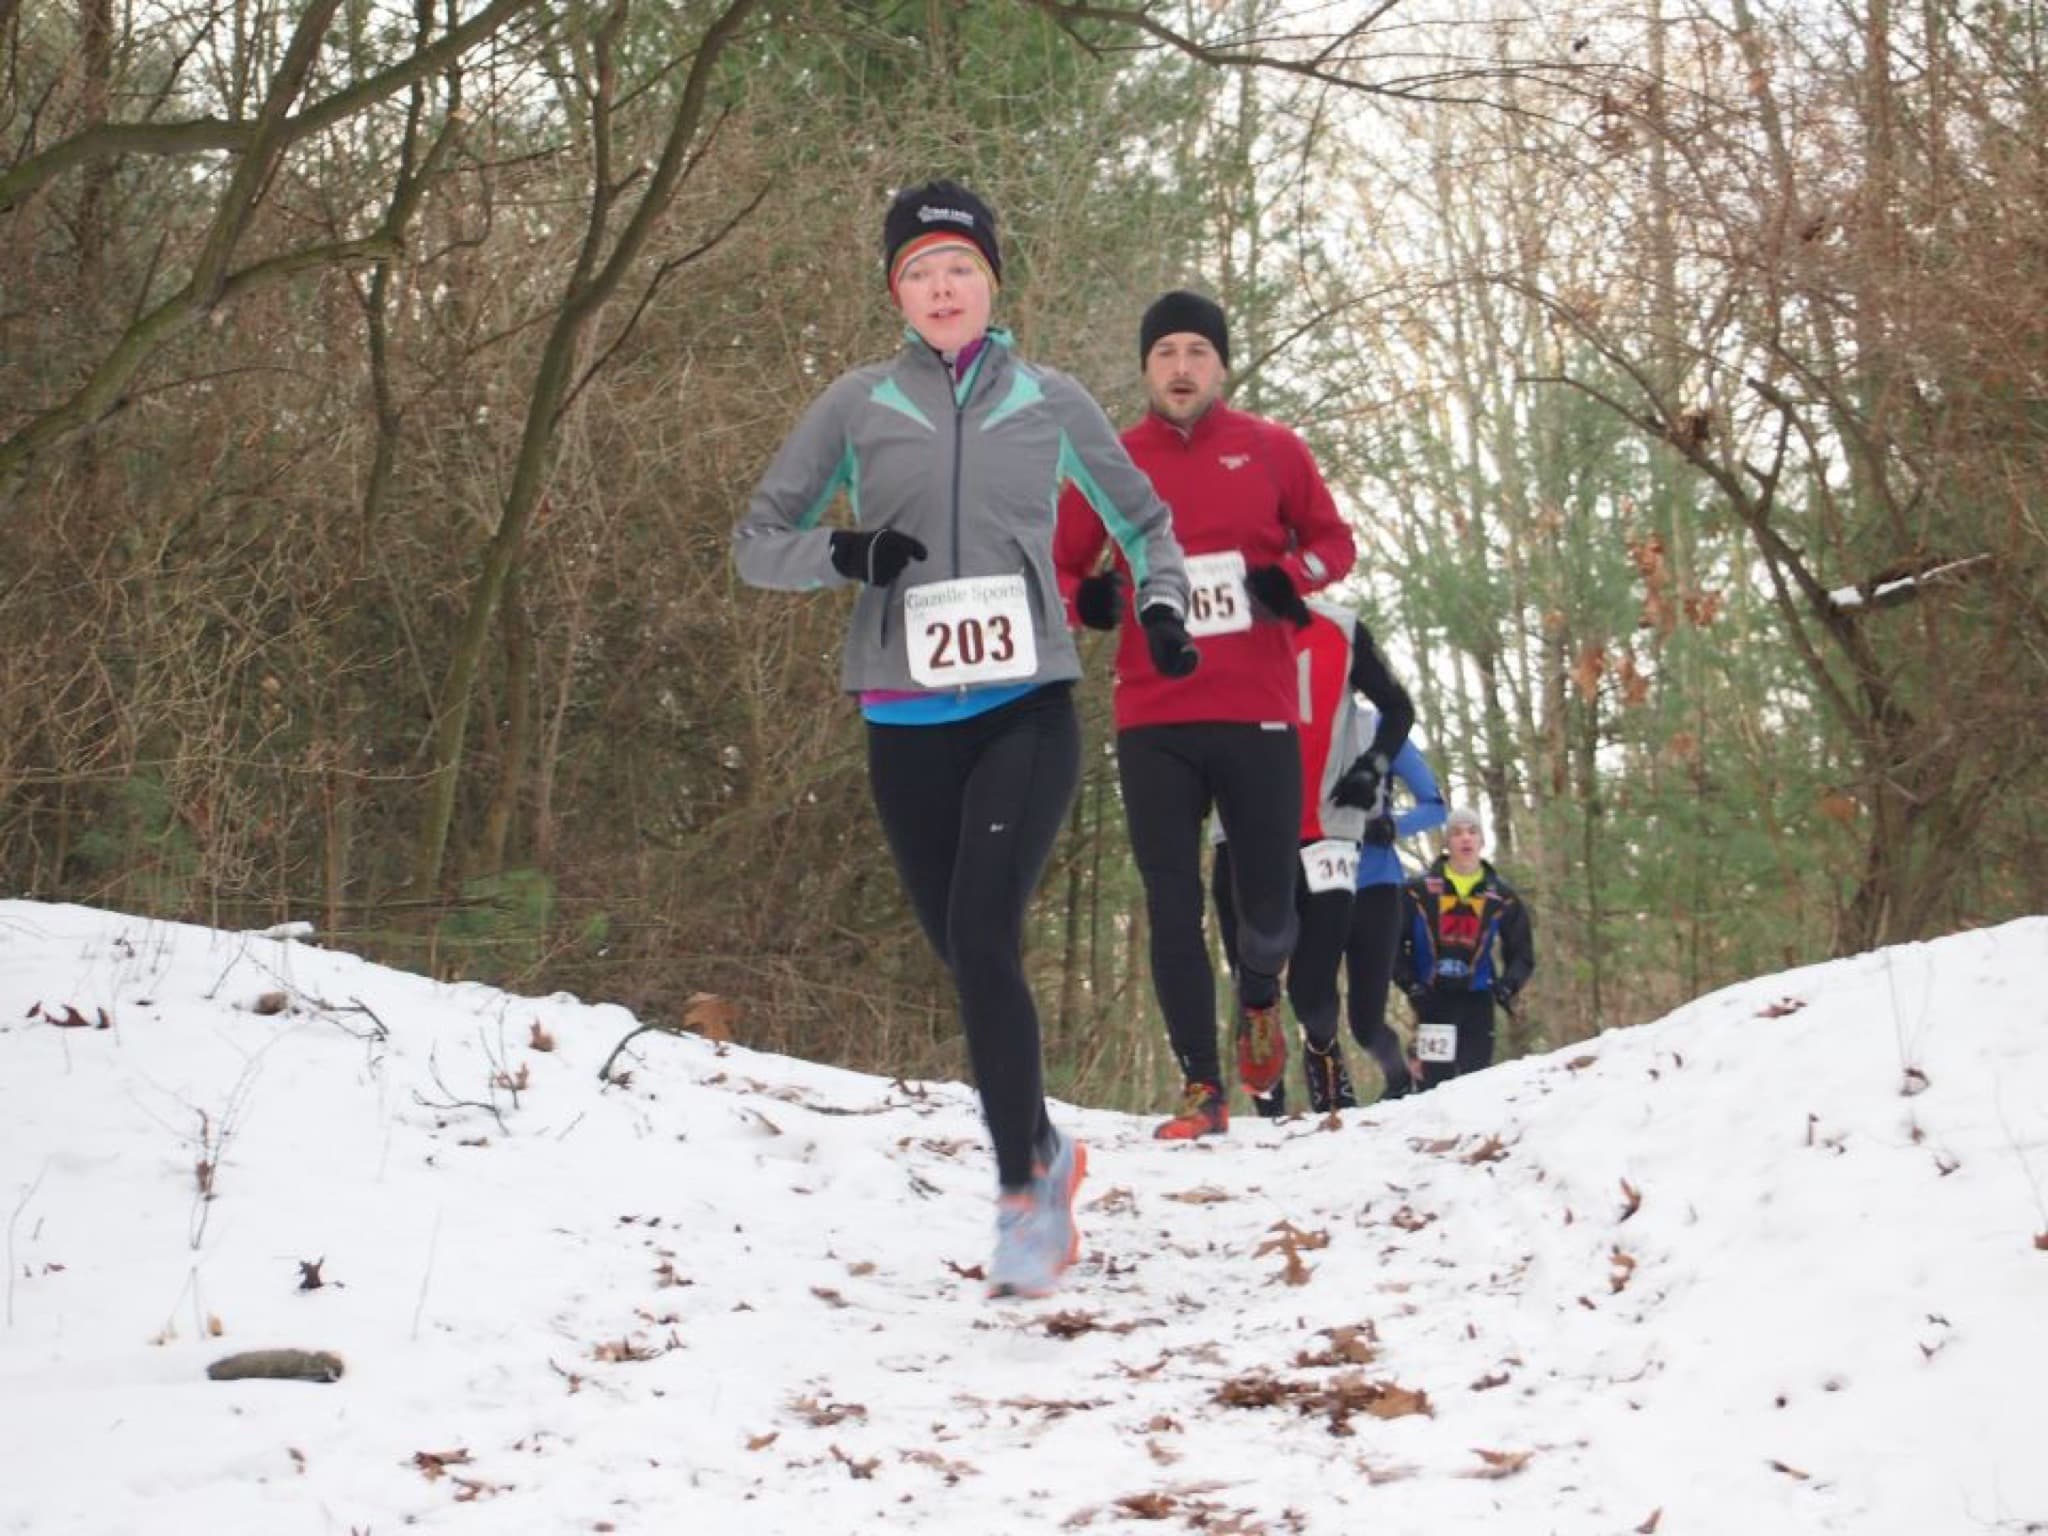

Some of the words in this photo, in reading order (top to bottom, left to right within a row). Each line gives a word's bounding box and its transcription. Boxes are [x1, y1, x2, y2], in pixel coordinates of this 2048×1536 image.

[906, 587, 965, 608] Gazelle
[971, 584, 1024, 604] Sports
[925, 615, 1014, 669] 203
